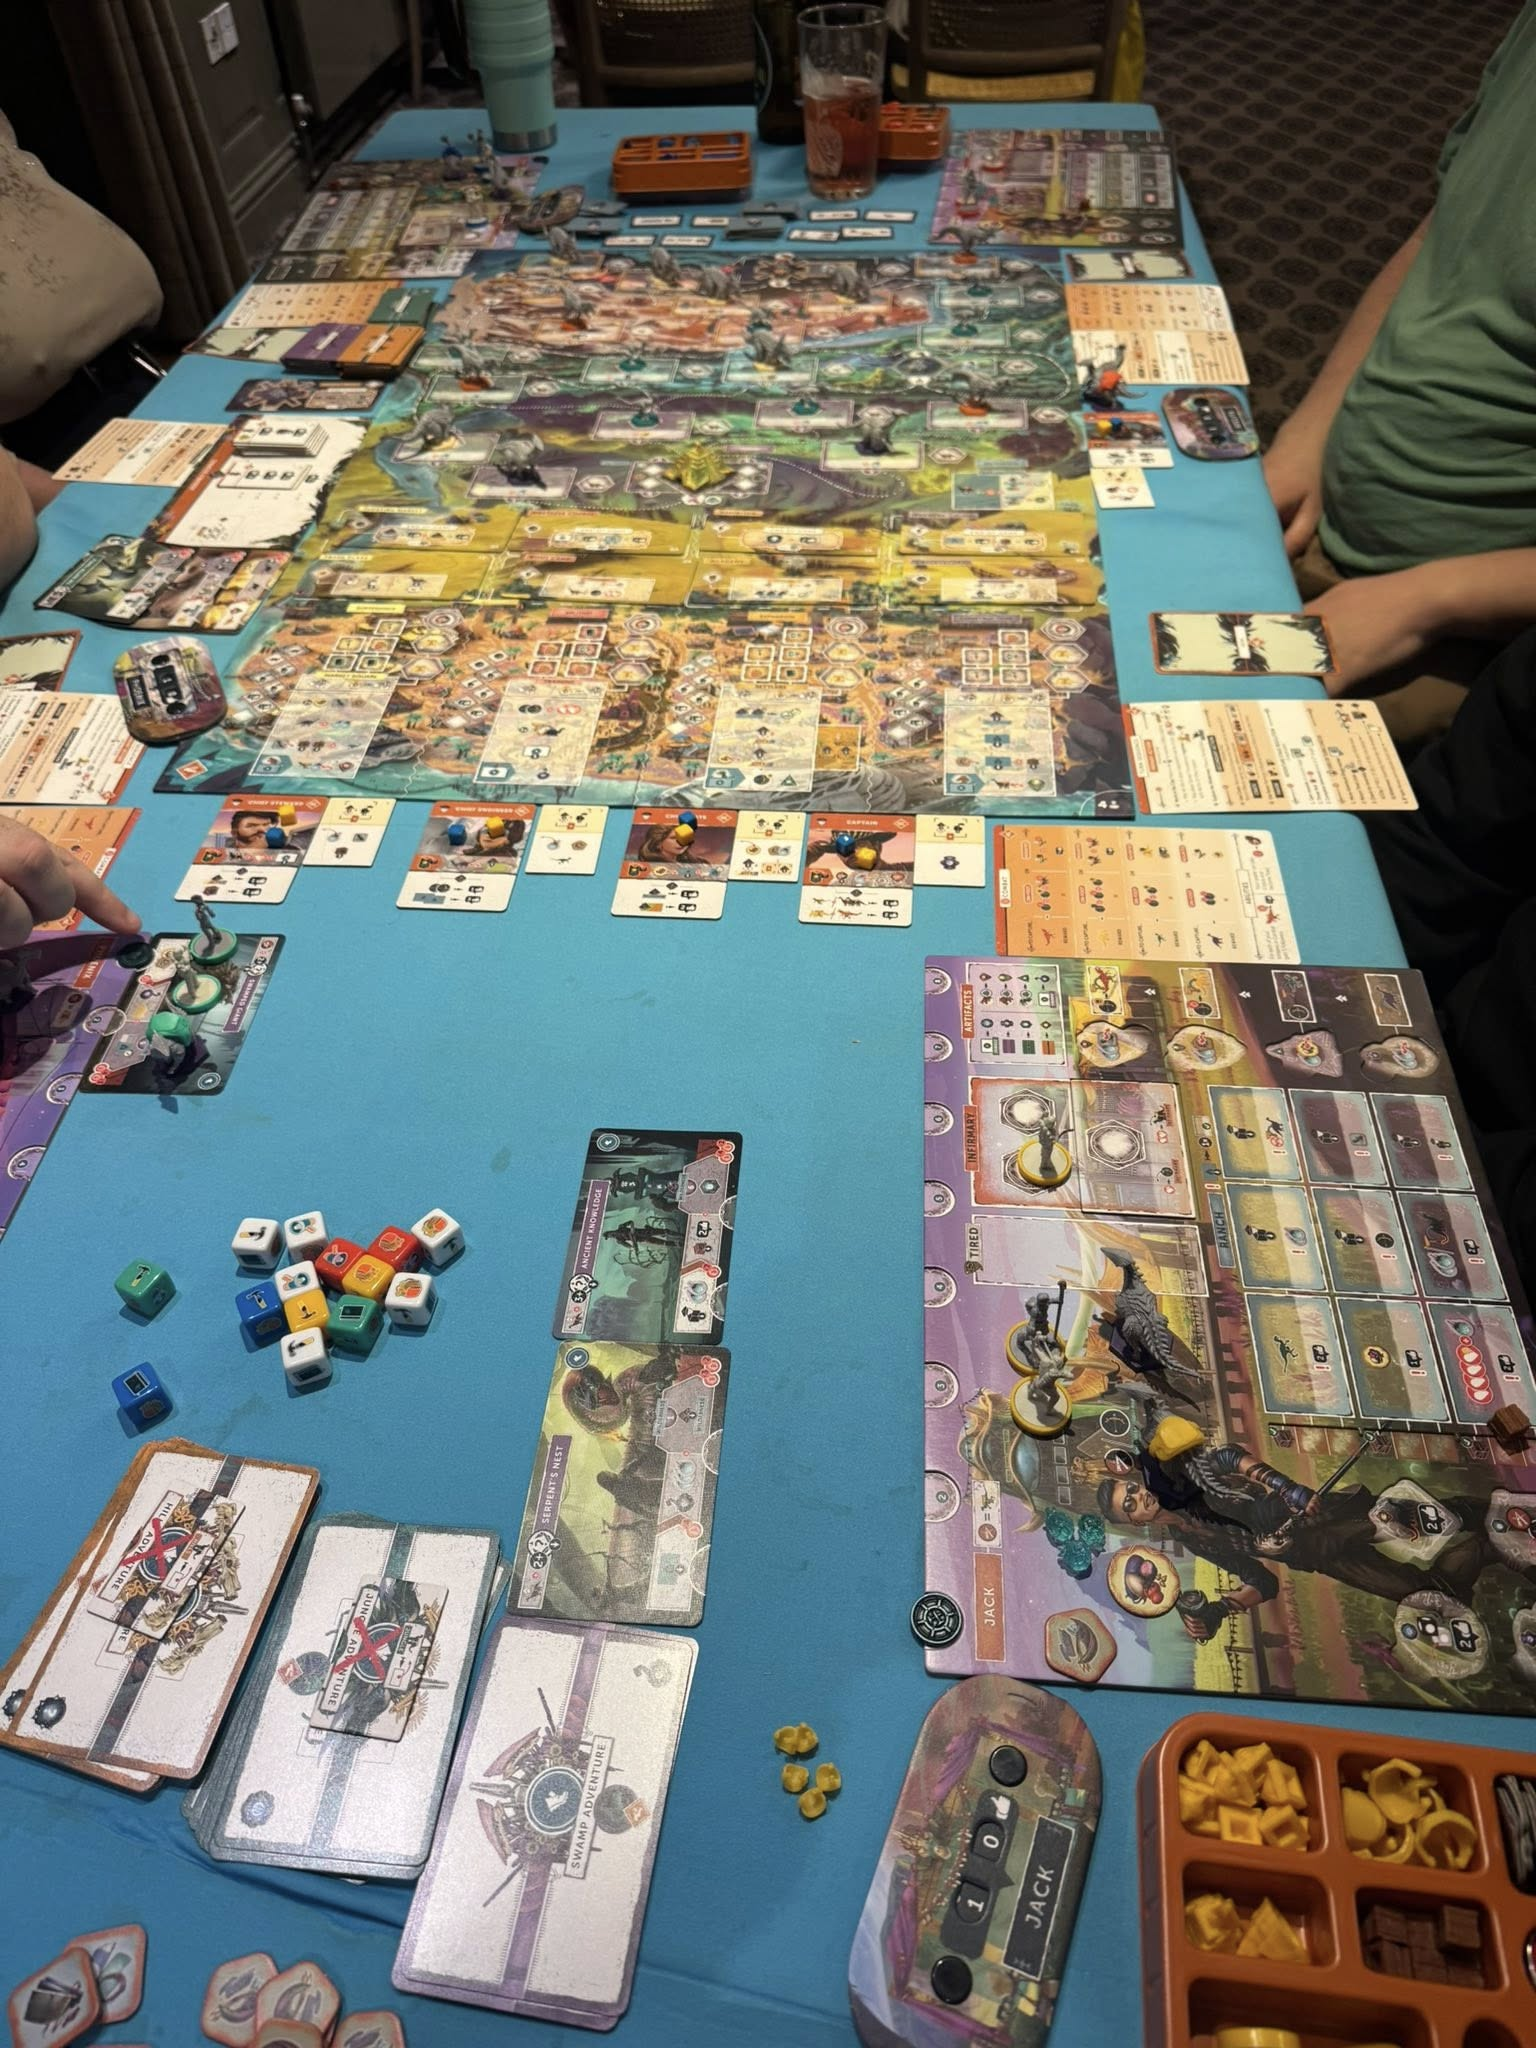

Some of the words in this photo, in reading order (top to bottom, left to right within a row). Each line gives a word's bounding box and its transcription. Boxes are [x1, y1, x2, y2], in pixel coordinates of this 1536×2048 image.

[846, 819, 879, 827] CAPTAIN
[1001, 876, 1009, 895] COMBAT
[239, 978, 256, 1007] SWAMPED
[964, 990, 972, 1033] ARTIFACTS
[231, 1007, 244, 1025] GIANT
[967, 1113, 977, 1163] INFIRMARY
[581, 1234, 594, 1270] ANCIENT
[589, 1188, 603, 1233] KNOWLEDGE
[969, 1227, 979, 1258] TIRED
[1214, 1211, 1229, 1249] RANCH
[541, 1471, 559, 1525] SERPENT'S
[553, 1445, 564, 1471] NEST
[111, 1530, 153, 1591] ADVETURE
[352, 1592, 374, 1636] JUNGE
[984, 1587, 996, 1627] JACK
[327, 1638, 359, 1706] ADVNTURE
[571, 1822, 588, 1870] SWAMP
[585, 1743, 607, 1818] ADVENTURE
[967, 1898, 984, 1913] 1
[982, 1834, 1000, 1849] 0
[1024, 1864, 1055, 1929] JACK
